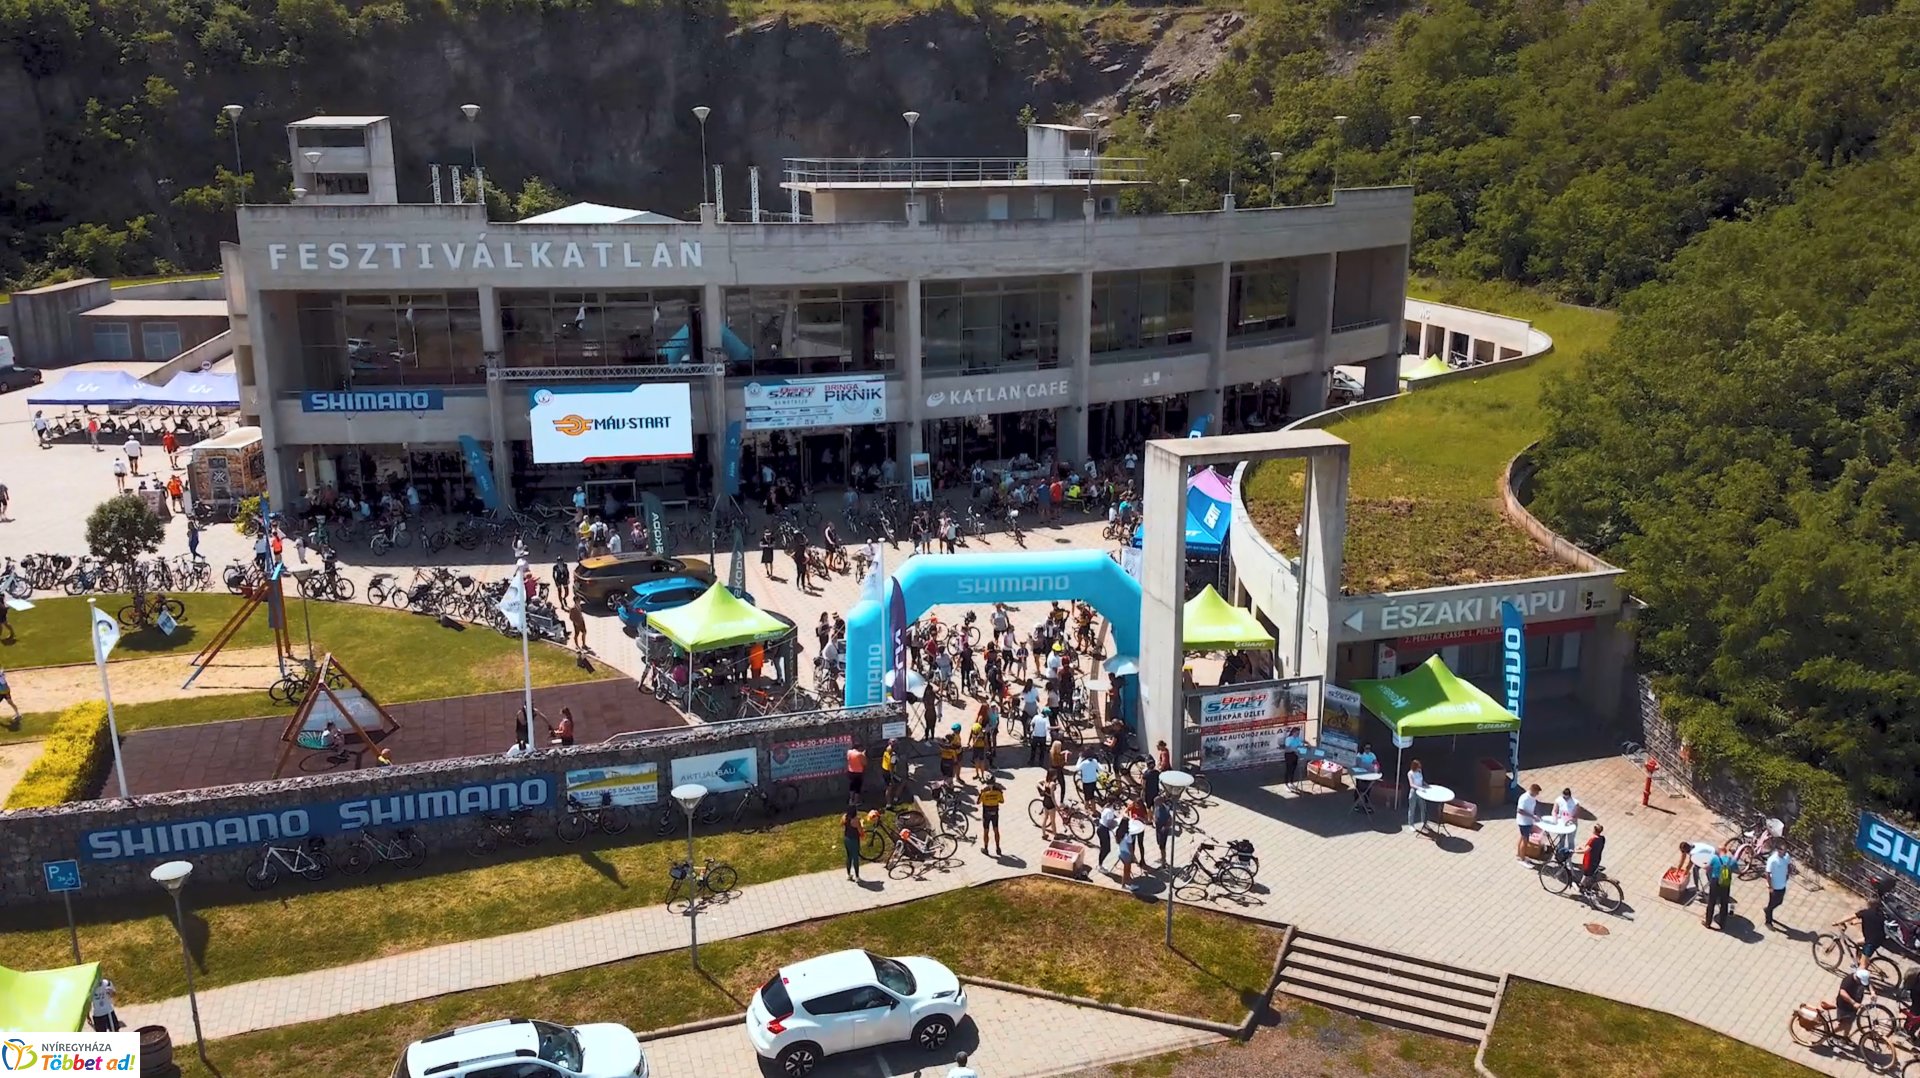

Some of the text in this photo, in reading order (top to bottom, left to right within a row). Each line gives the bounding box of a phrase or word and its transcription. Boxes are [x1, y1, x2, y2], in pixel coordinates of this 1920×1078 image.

[268, 233, 703, 270] FESZTIVÁLKATLAN
[311, 392, 430, 410] SHIMANO
[950, 381, 1069, 405] KATLAN CAFE
[957, 575, 1071, 594] SHIMANO
[1381, 597, 1483, 631] ÉSZAKI
[339, 778, 549, 830] SHIMANO
[88, 809, 310, 859] SHIMANO
[1867, 823, 1920, 877] SH
[48, 866, 59, 879] P
